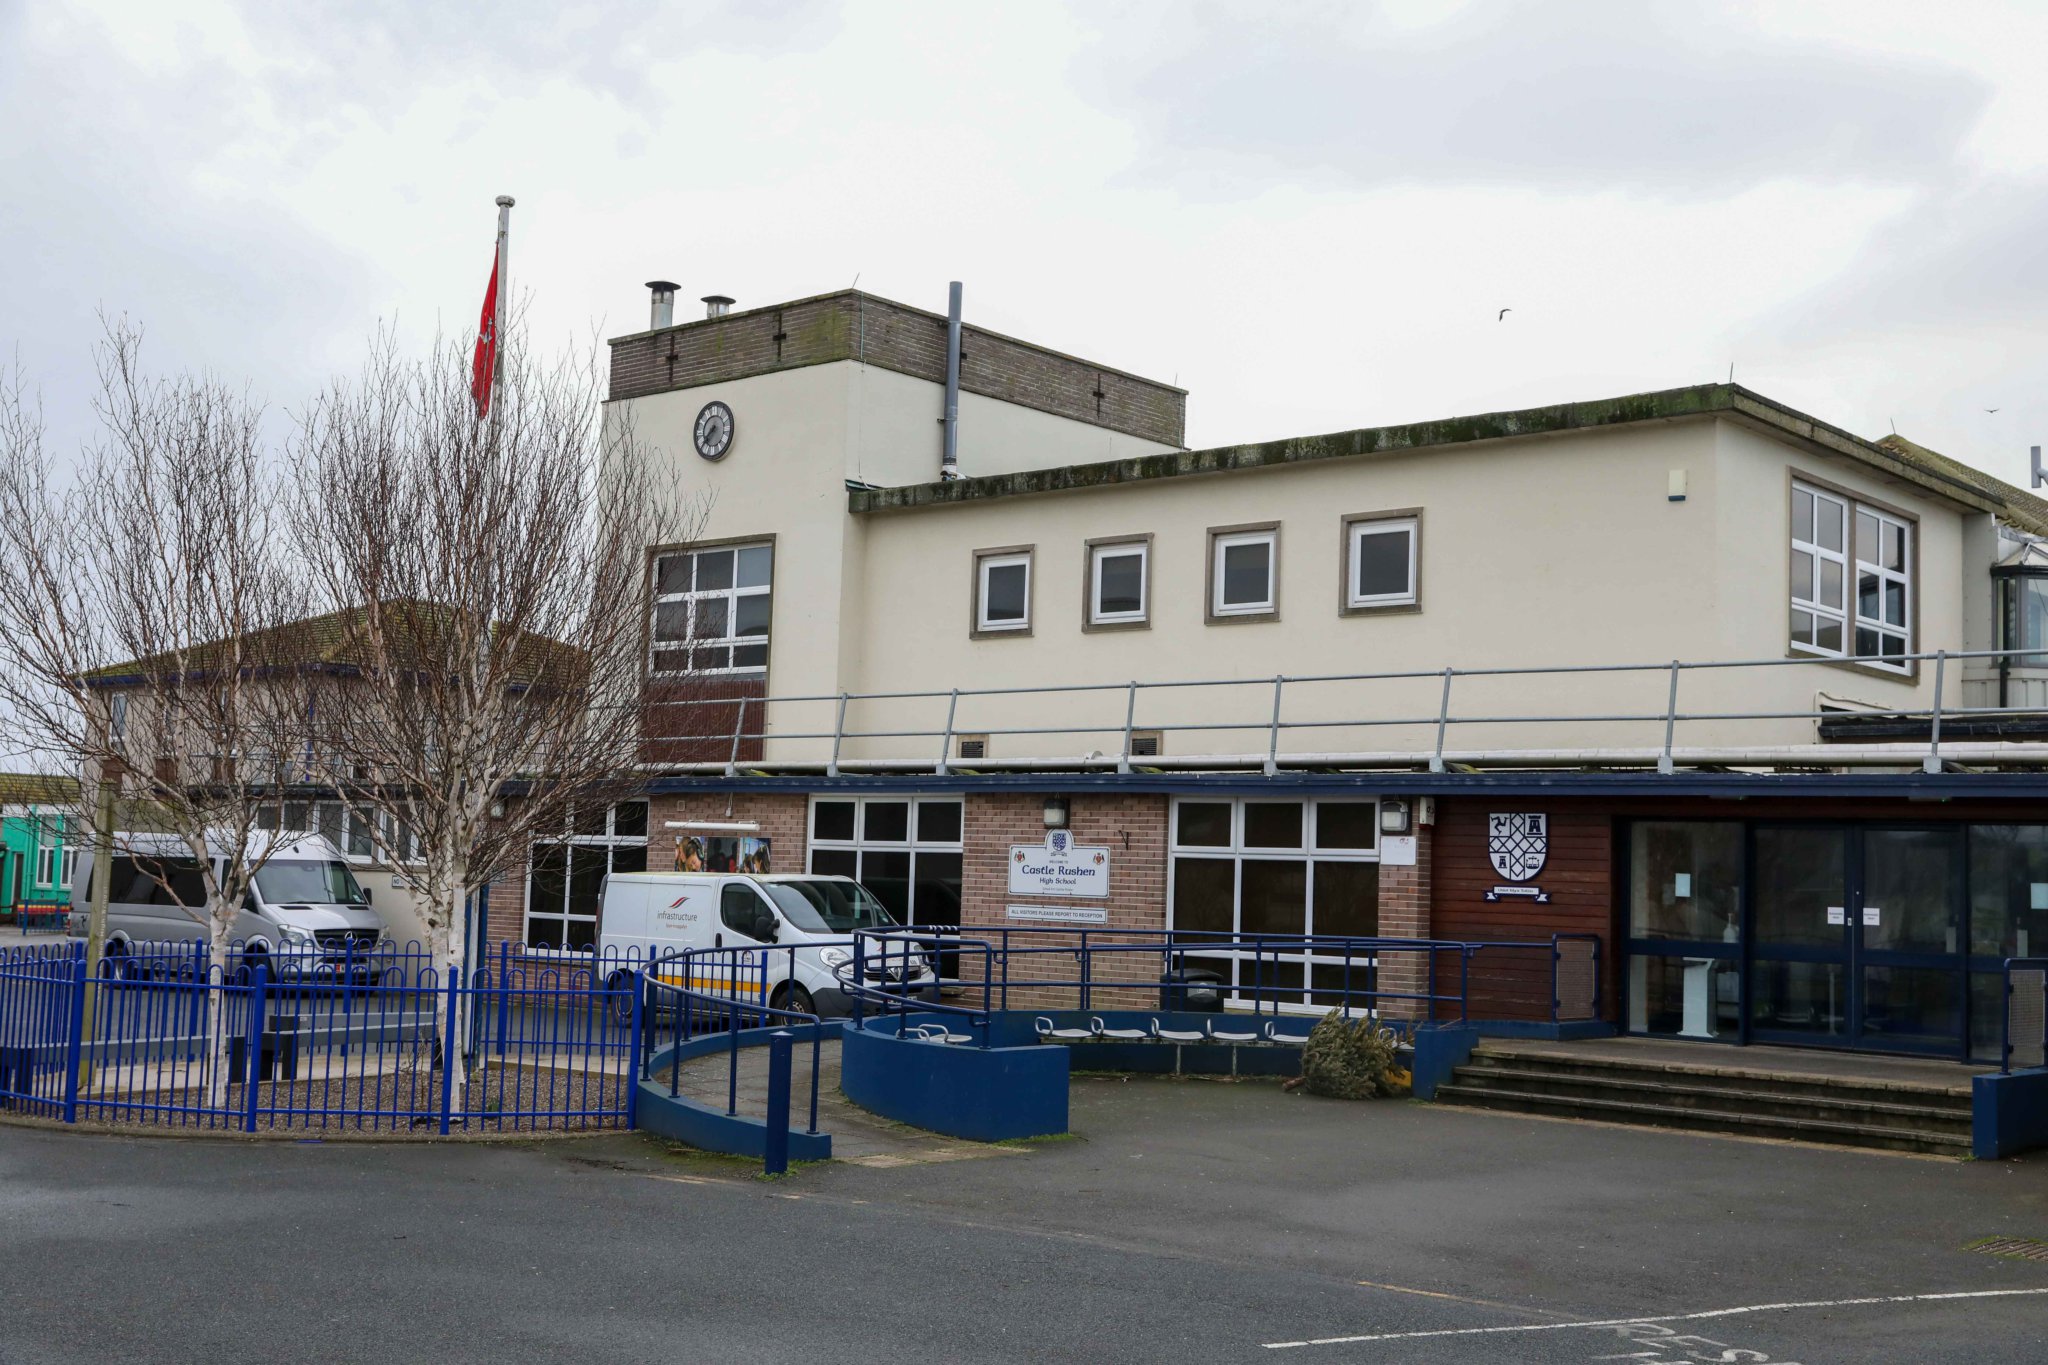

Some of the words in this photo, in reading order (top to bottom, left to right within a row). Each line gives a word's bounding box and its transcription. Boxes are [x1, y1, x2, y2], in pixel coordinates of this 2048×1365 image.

[1022, 864, 1054, 876] Castle
[1058, 865, 1096, 877] Rushen
[1055, 877, 1077, 885] School
[656, 910, 698, 922] infrastructure
